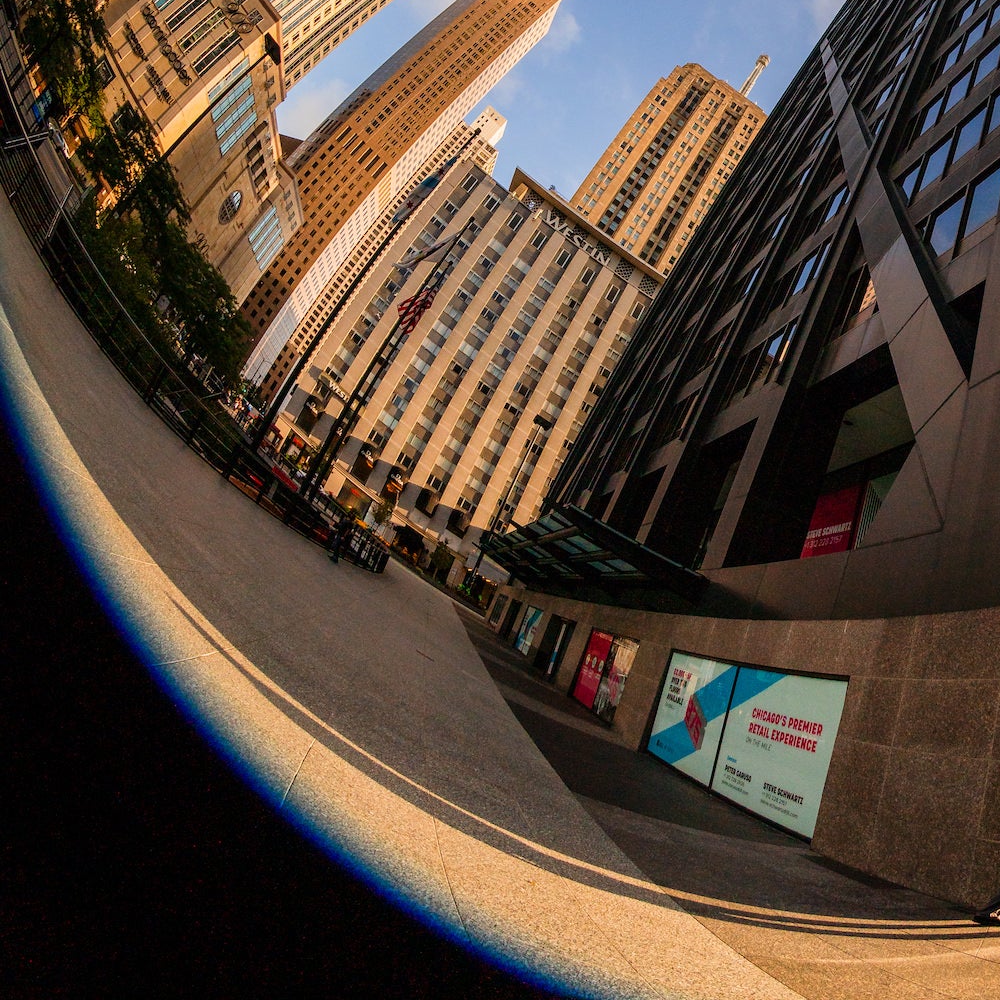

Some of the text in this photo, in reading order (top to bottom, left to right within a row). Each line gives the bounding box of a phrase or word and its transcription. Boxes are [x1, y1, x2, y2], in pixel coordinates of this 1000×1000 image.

[545, 209, 611, 267] WESTIN
[752, 707, 823, 736] CHICAGO'S PREMIER
[748, 722, 818, 753] RETAIL EXPERIENCE
[724, 764, 736, 775] PETER
[763, 782, 777, 794] STEVE
[777, 787, 804, 805] SCHWARTZ
